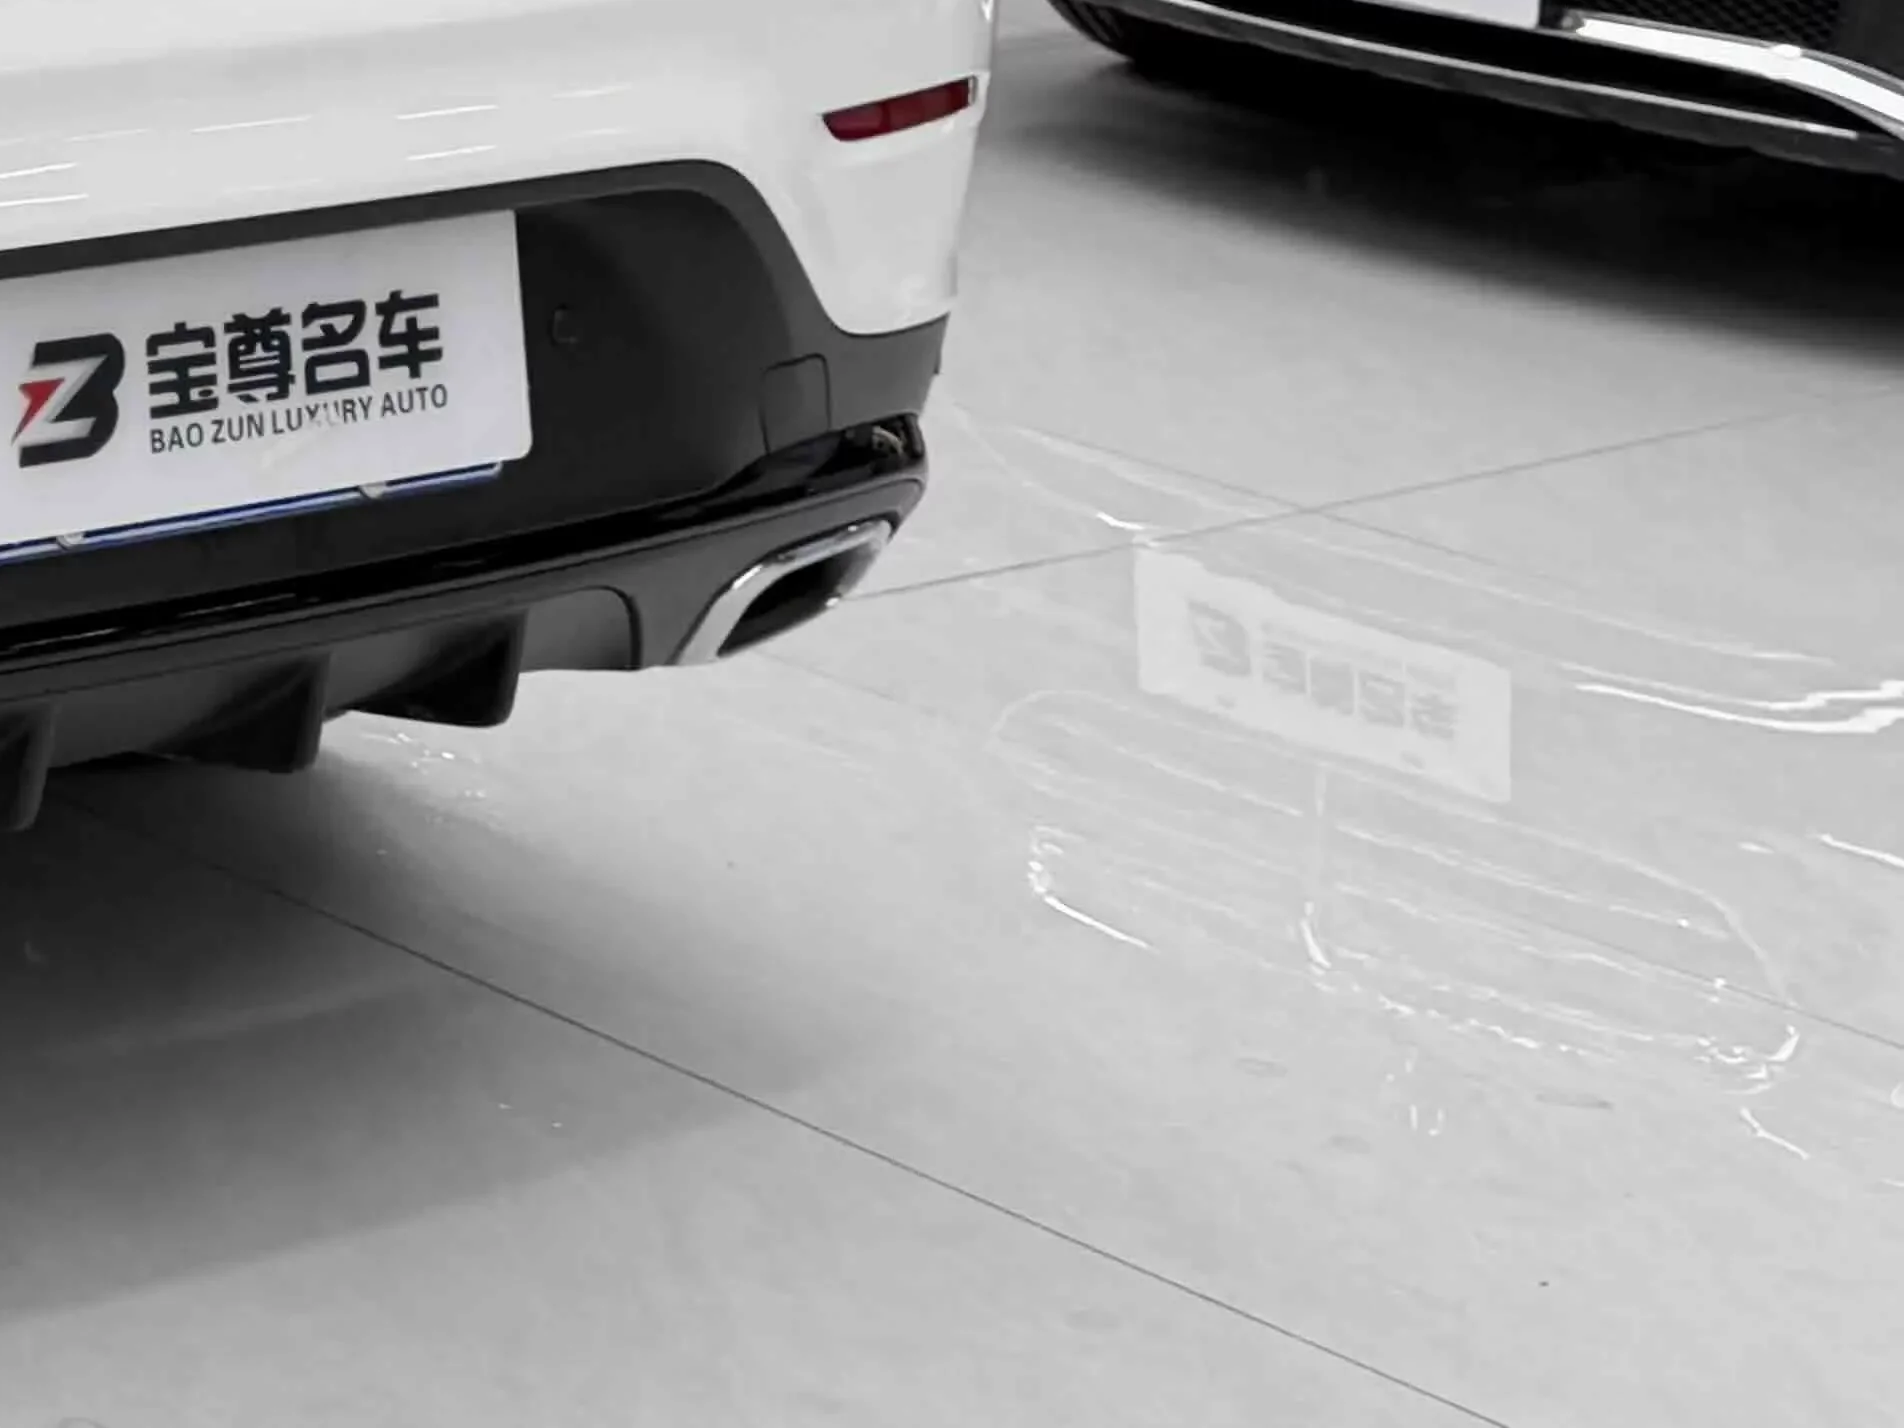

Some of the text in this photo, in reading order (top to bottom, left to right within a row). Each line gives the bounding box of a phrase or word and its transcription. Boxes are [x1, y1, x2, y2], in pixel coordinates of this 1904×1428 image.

[146, 289, 444, 420] 宝尊名车
[149, 422, 204, 454] BAO
[210, 406, 265, 445] ZUN
[380, 383, 448, 418] AUTO
